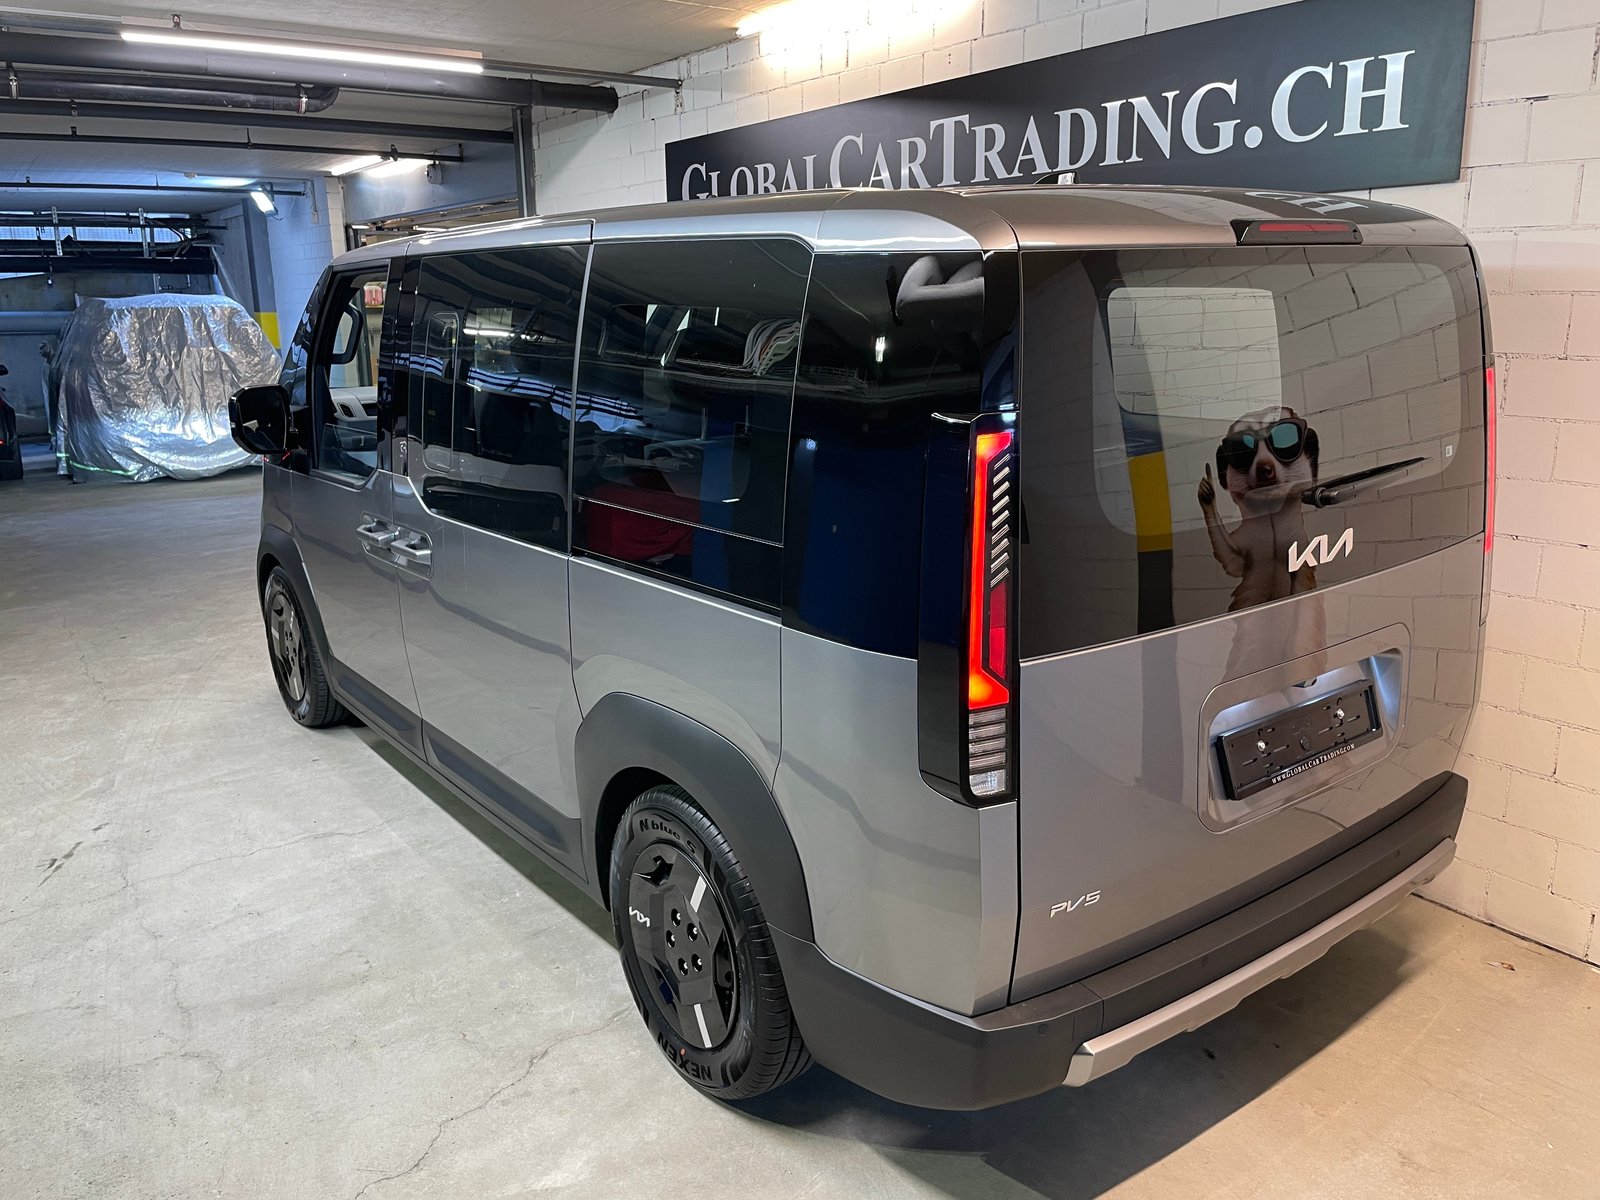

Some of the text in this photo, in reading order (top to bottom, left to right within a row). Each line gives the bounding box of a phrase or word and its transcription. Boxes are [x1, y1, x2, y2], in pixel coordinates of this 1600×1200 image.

[1288, 527, 1354, 573] KIA
[1049, 889, 1101, 918] PV5
[657, 1031, 713, 1081] NEXEN
